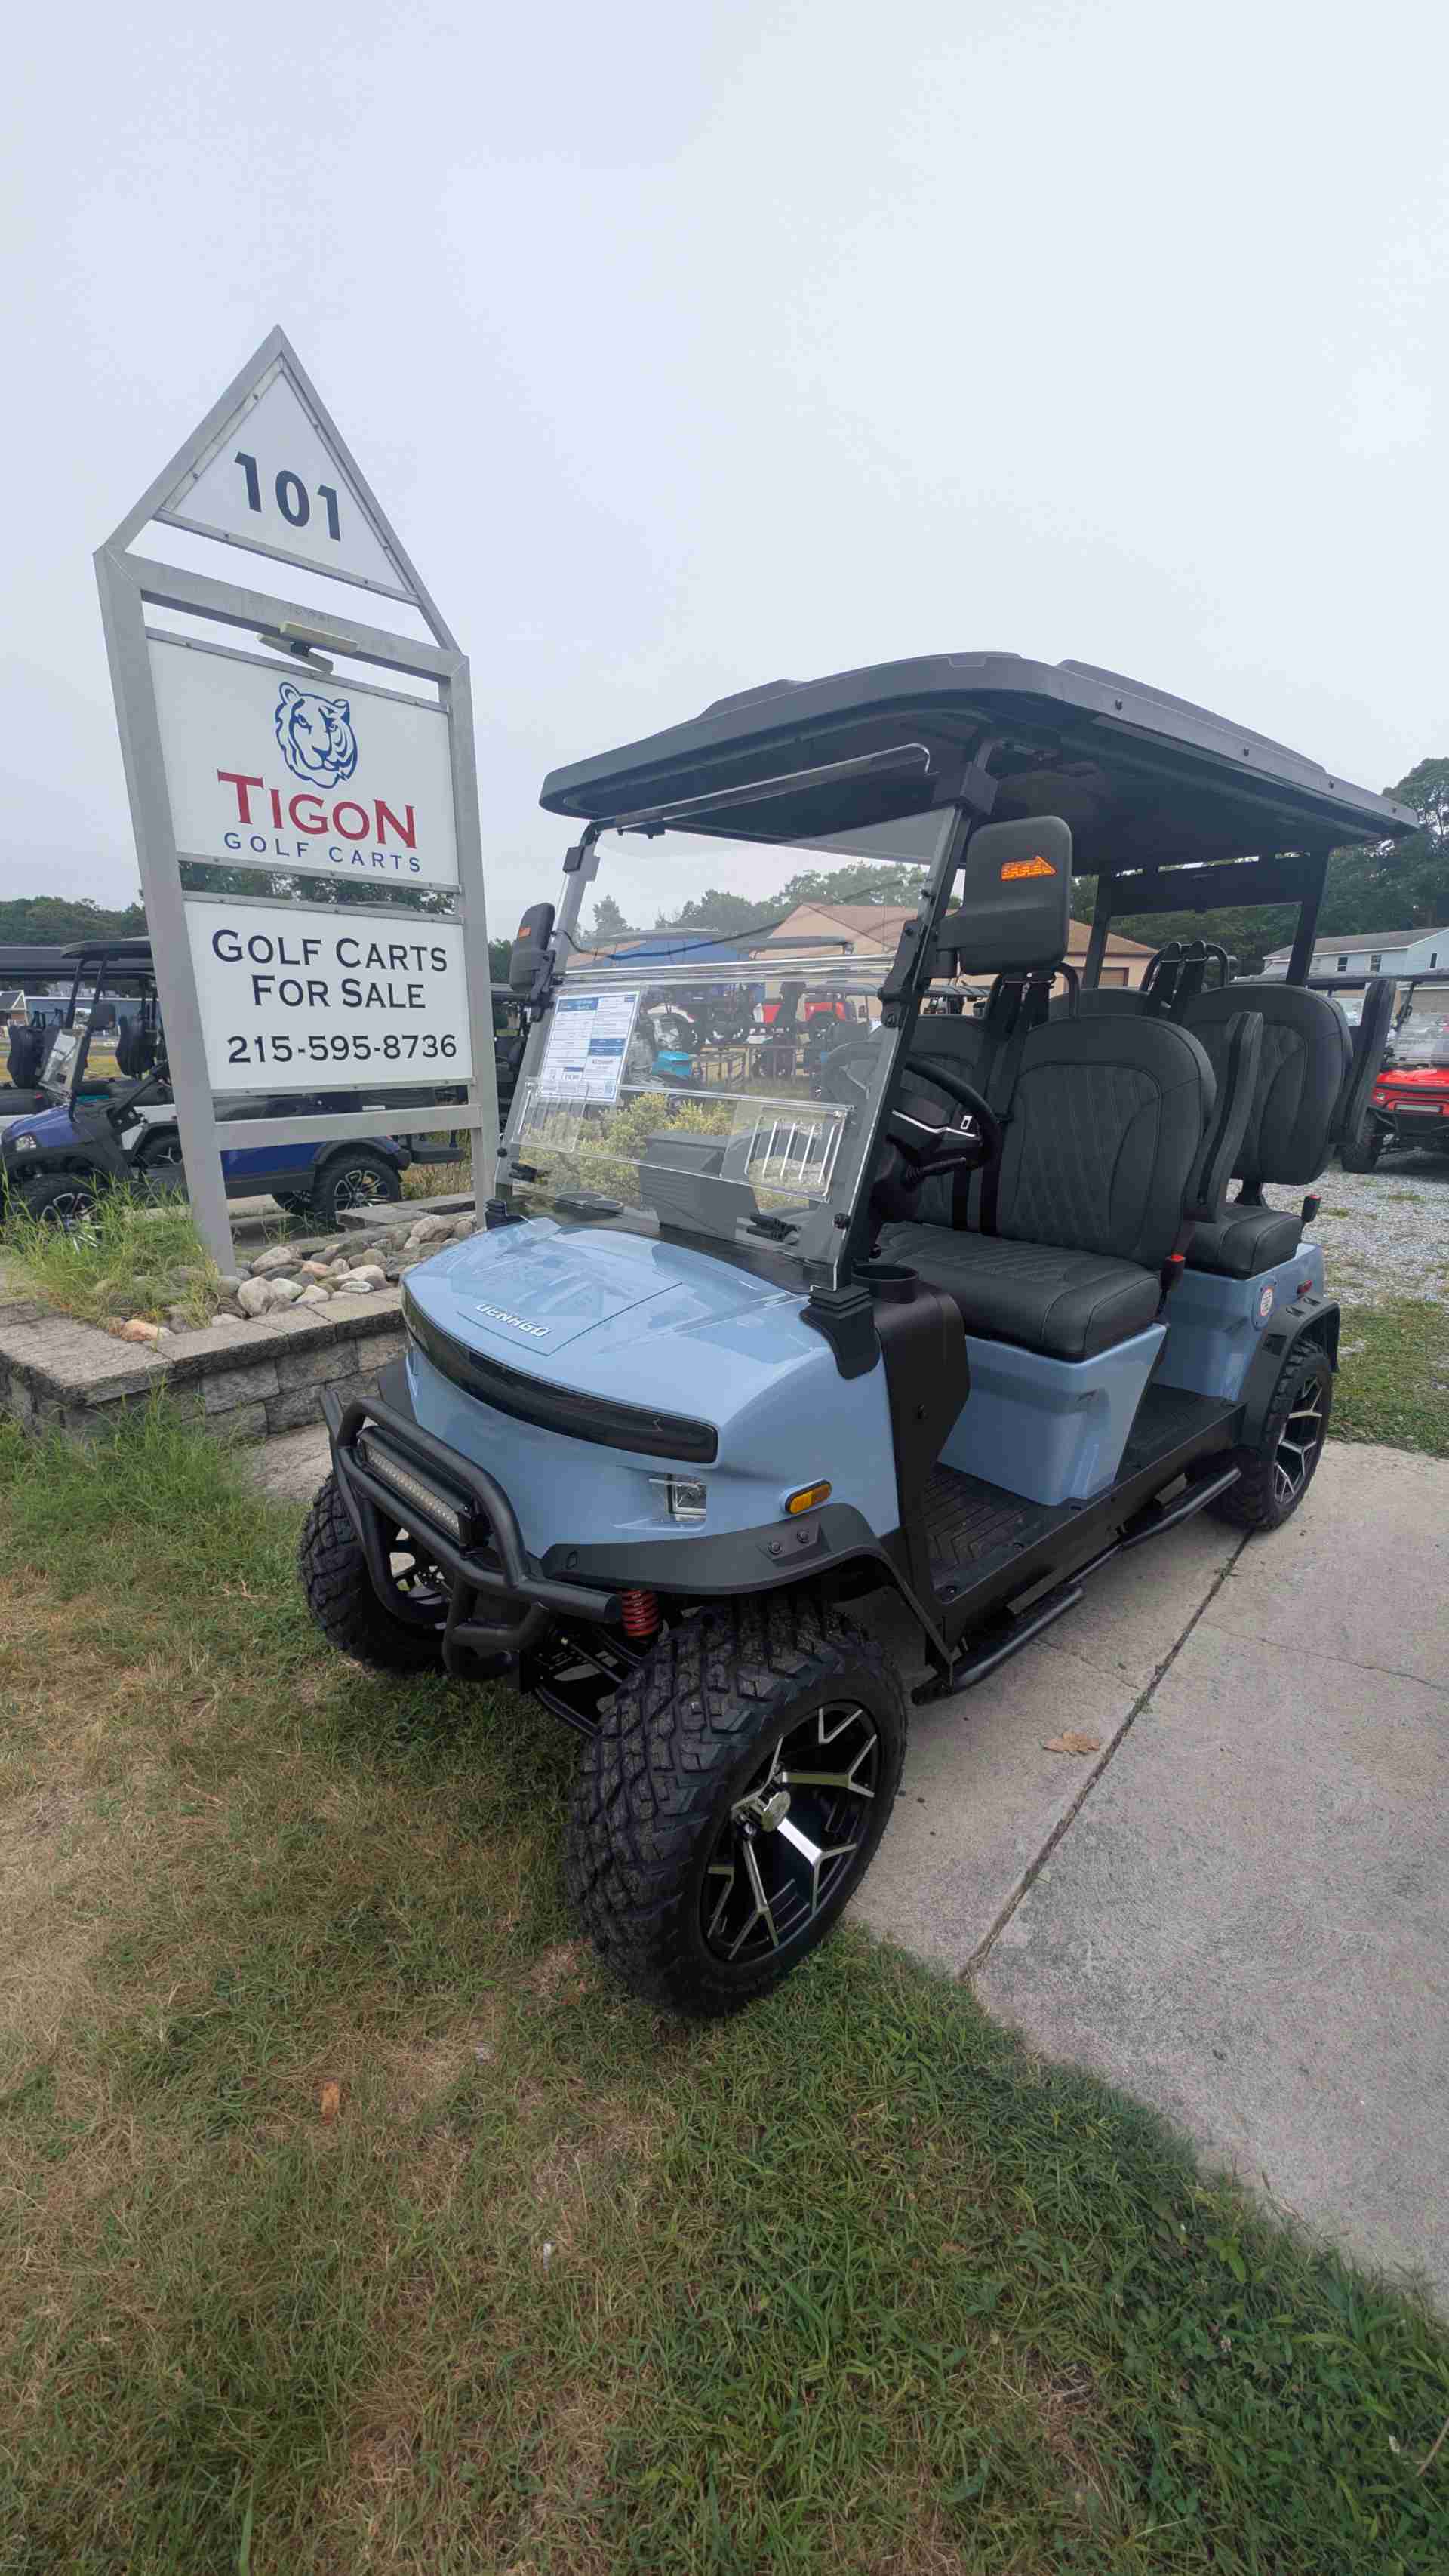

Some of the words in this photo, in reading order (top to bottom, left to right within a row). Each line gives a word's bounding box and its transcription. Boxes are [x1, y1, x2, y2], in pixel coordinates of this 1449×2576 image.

[235, 451, 341, 542] 101
[218, 771, 417, 849] TIGON
[224, 833, 309, 858] GOLF
[328, 846, 421, 873] CARTS
[212, 929, 321, 967] GOLF
[336, 937, 448, 972] CARTS
[252, 974, 330, 1007] FOR
[342, 979, 426, 1008] SALE
[228, 1033, 457, 1063] 215-595-8736
